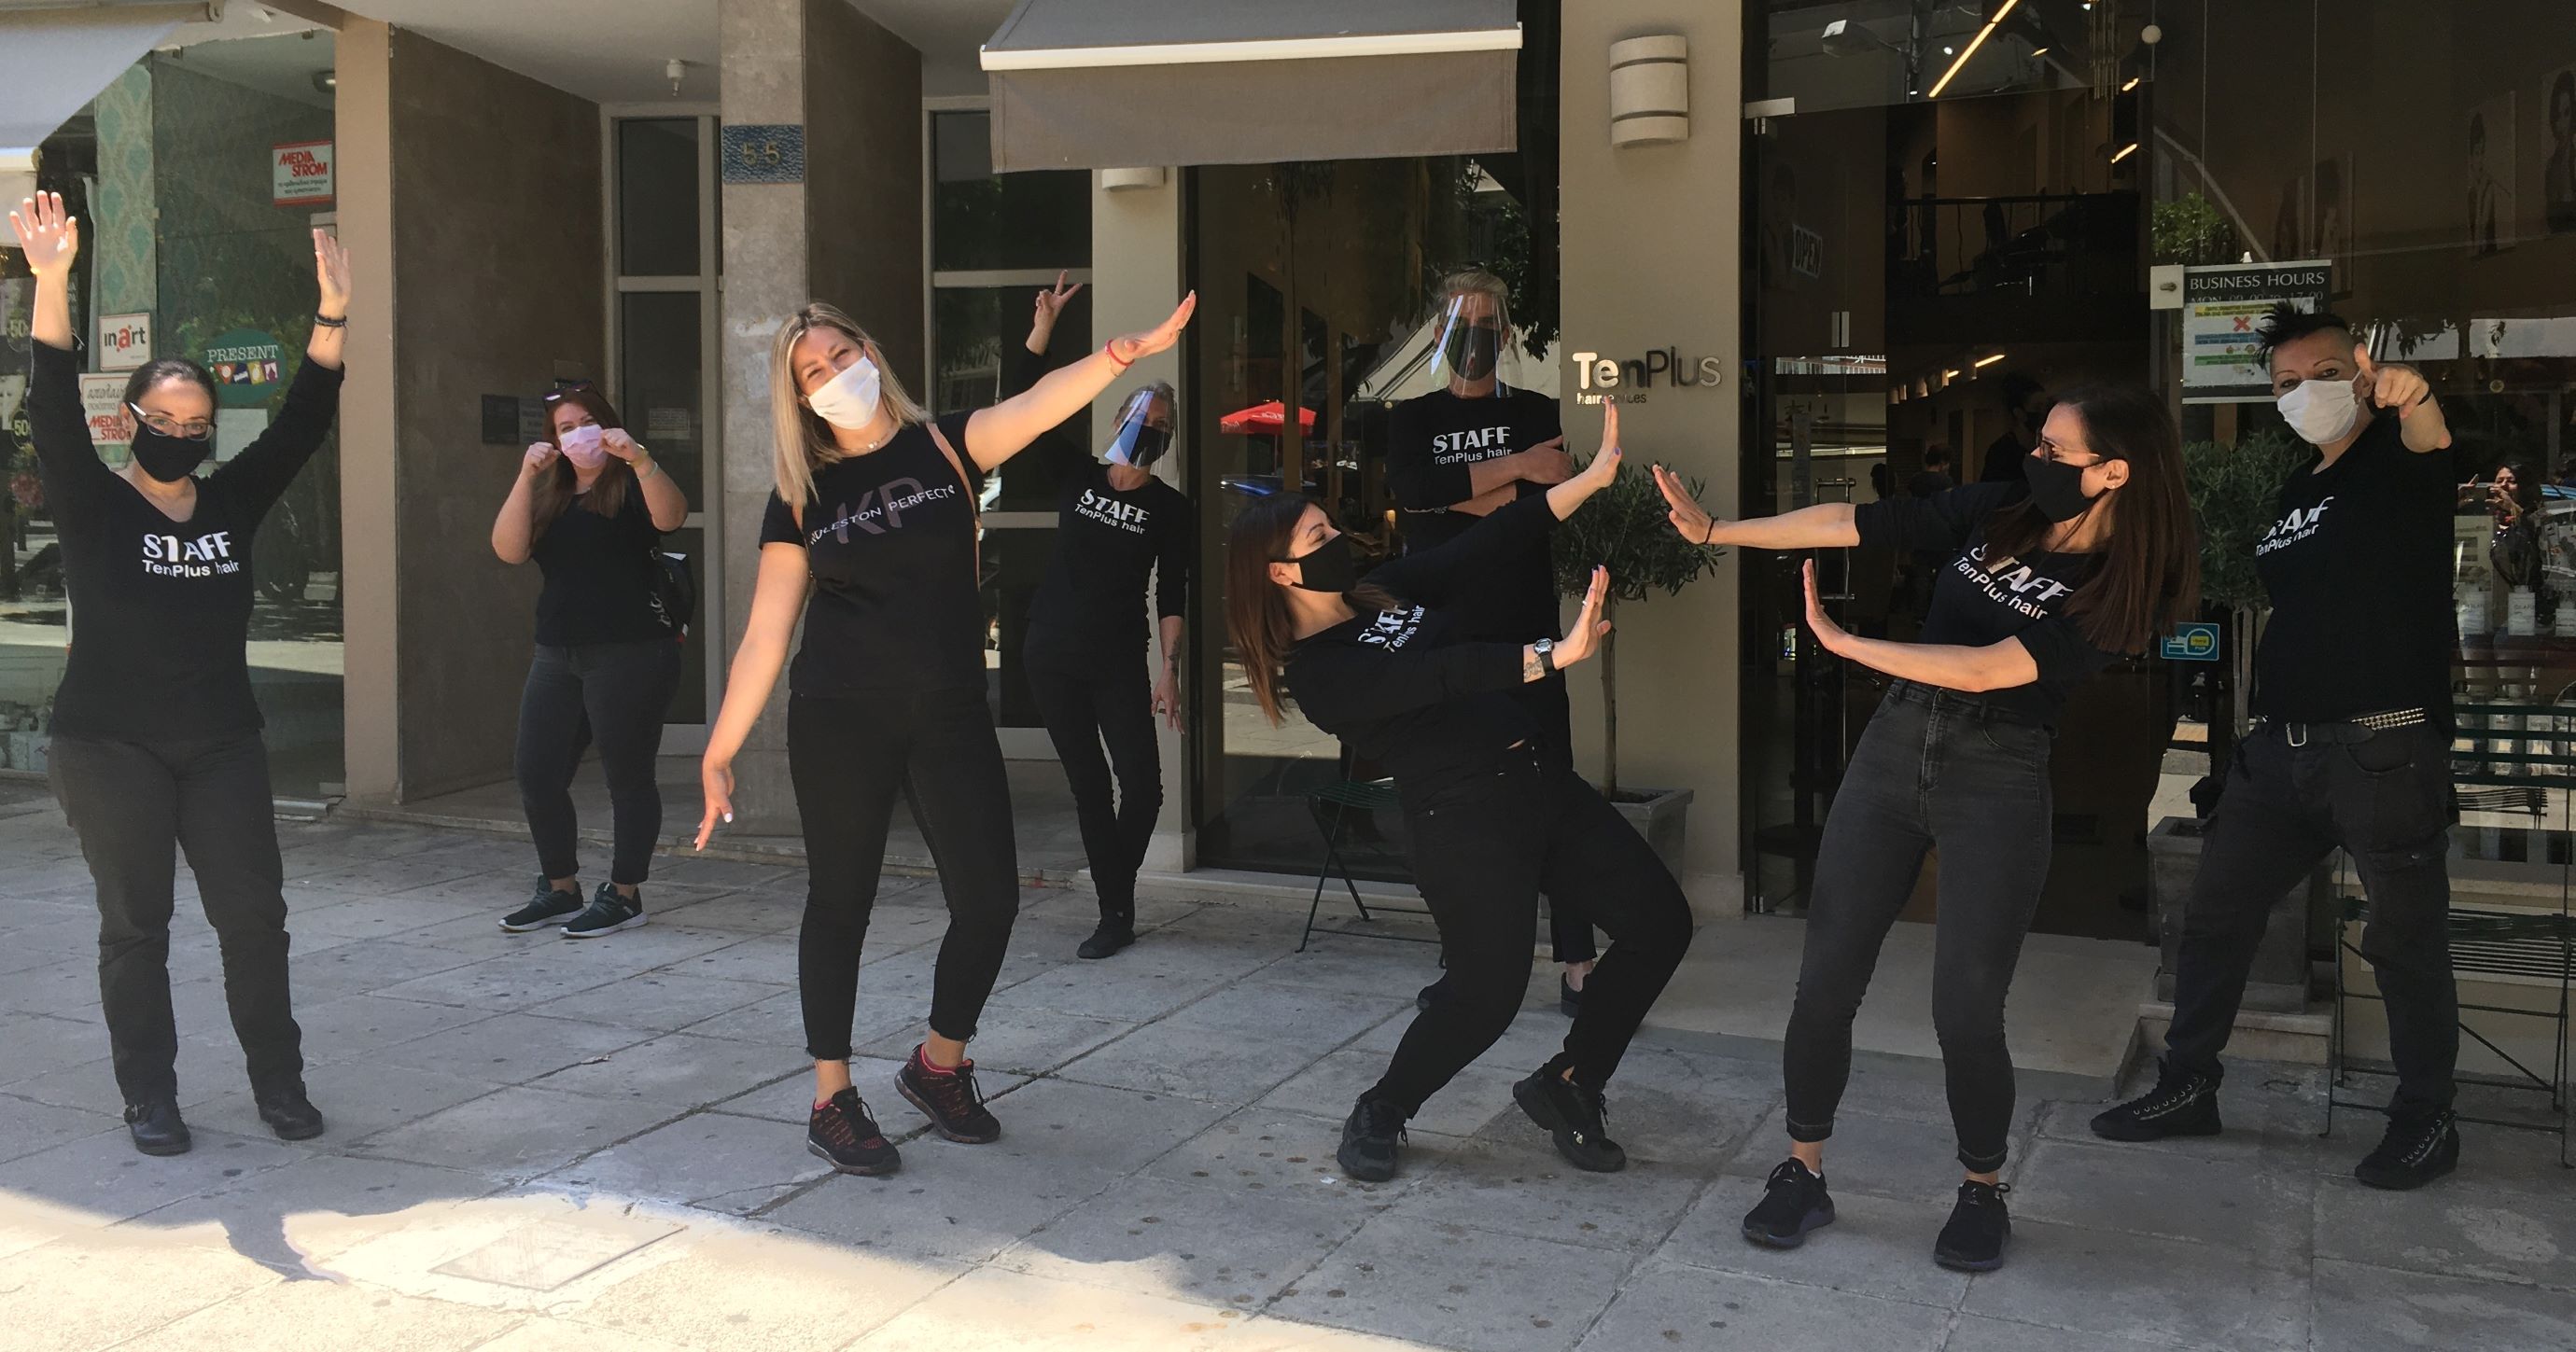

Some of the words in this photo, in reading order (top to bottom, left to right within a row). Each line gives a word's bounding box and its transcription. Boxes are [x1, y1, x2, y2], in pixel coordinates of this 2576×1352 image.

[279, 150, 315, 166] MEDIA
[742, 140, 780, 166] 55
[292, 161, 328, 177] STROM
[1795, 230, 1821, 274] OPEN
[2190, 274, 2261, 290] BUSINESS
[2267, 272, 2325, 286] HOURS
[104, 327, 146, 351] inart
[207, 344, 278, 363] PRESENT
[1572, 345, 1722, 390] TenPlus
[1433, 426, 1511, 453] STAFF
[1435, 450, 1482, 465] TenPlus
[1487, 447, 1512, 458] hair
[837, 477, 924, 544] KP
[1081, 488, 1150, 523] STAFF
[1121, 521, 1145, 535] hair
[143, 531, 231, 562] STAFF
[142, 559, 211, 578] TenPlus
[215, 560, 239, 574] hair
[1953, 557, 2008, 603] TenPlus
[2008, 595, 2048, 620] hair
[1407, 605, 1425, 623] hair
